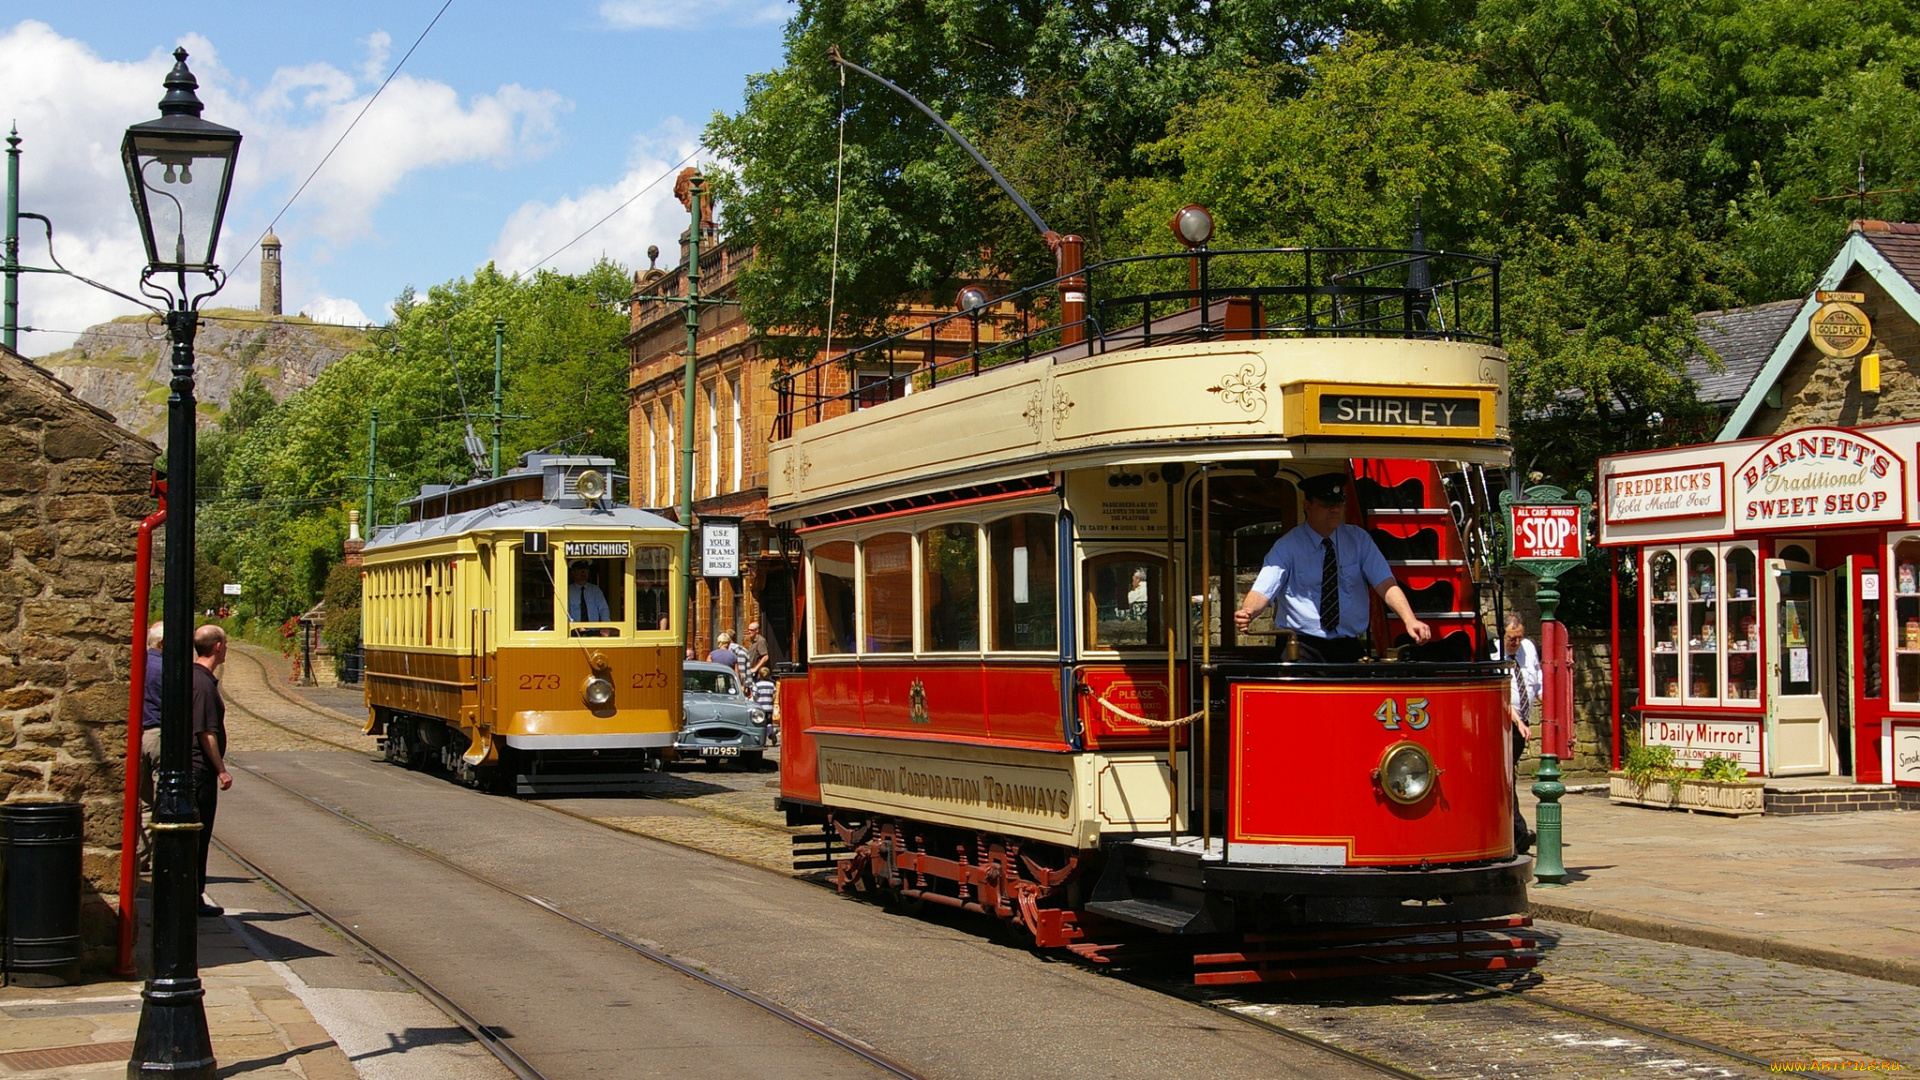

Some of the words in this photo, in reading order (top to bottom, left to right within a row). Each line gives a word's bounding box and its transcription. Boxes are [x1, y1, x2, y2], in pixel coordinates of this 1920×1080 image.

[1818, 325, 1838, 334] GOLD
[1839, 326, 1863, 335] FLAKE
[1336, 397, 1458, 426] SHIRLEY
[1744, 436, 1891, 494] BARNETT'S
[1615, 472, 1711, 498] FREDERICK'S
[1764, 466, 1867, 495] Traditional
[1517, 509, 1530, 517] ALL
[1531, 509, 1548, 517] CARS
[1551, 509, 1575, 517] INWARD
[1616, 499, 1640, 518] Gold
[1645, 495, 1683, 511] Medal
[1686, 493, 1711, 507] Ices
[1746, 496, 1819, 521] SWEET
[1824, 491, 1888, 516] SHOP
[710, 539, 731, 547] YOUR
[1522, 517, 1571, 549] STOP
[565, 543, 629, 556] MATOSINHOS
[706, 548, 735, 556] TRAMS
[519, 674, 561, 690] 273
[632, 672, 668, 689] 273
[1119, 690, 1154, 700] PLEASE
[1373, 697, 1430, 730] 45
[1660, 722, 1694, 748] Daily
[1696, 723, 1743, 744] Mirror
[1684, 750, 1707, 760] ALONG
[1725, 752, 1743, 761] LINE
[826, 758, 896, 793] SOUTHAMPTON
[899, 766, 980, 806] CORPORATION
[984, 775, 1070, 820] TRAMWAYS
